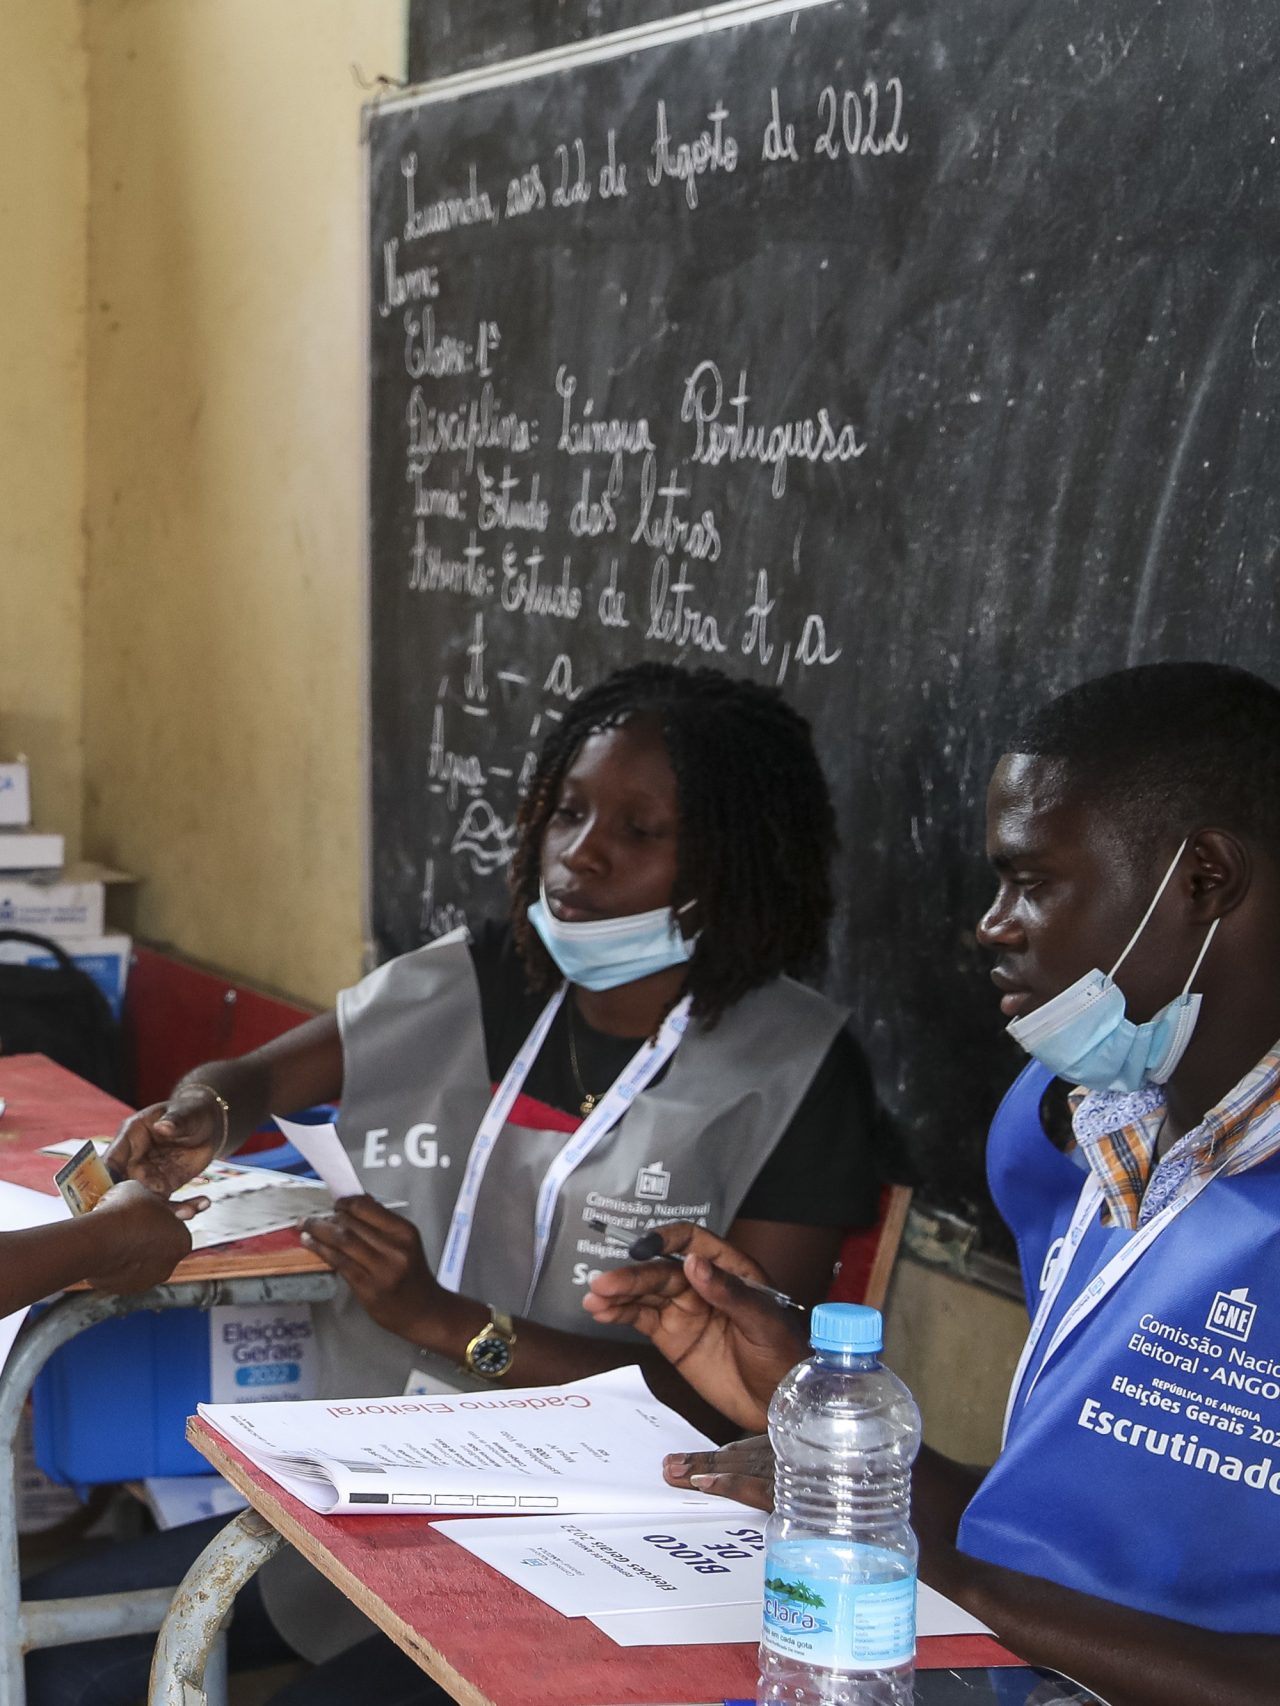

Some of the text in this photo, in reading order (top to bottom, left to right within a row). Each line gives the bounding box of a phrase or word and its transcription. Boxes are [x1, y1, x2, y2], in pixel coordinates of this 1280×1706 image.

[648, 100, 739, 209] Agosto
[762, 87, 799, 162] de
[814, 77, 909, 160] 2022
[681, 360, 867, 498] Portuguesa
[631, 452, 720, 562] letras
[646, 554, 727, 651] letra
[363, 1123, 451, 1169] E.G.
[222, 1319, 312, 1345] Eleições
[1139, 1313, 1223, 1358] Comissão
[1213, 1301, 1250, 1333] CNE
[232, 1343, 303, 1363] Gerais
[1127, 1333, 1200, 1374] Eleitoral
[326, 1394, 592, 1419] Caderno Eleitoral
[1110, 1375, 1181, 1415] Eleições
[1185, 1405, 1245, 1436] Gerais
[1151, 1378, 1261, 1423] REPÚBLICA DE ANGOLA
[560, 1524, 679, 1591] Eleições Gerais 2022
[643, 1534, 731, 1574] BLOCO
[702, 1542, 753, 1559] DE
[796, 1639, 813, 1650] gota
